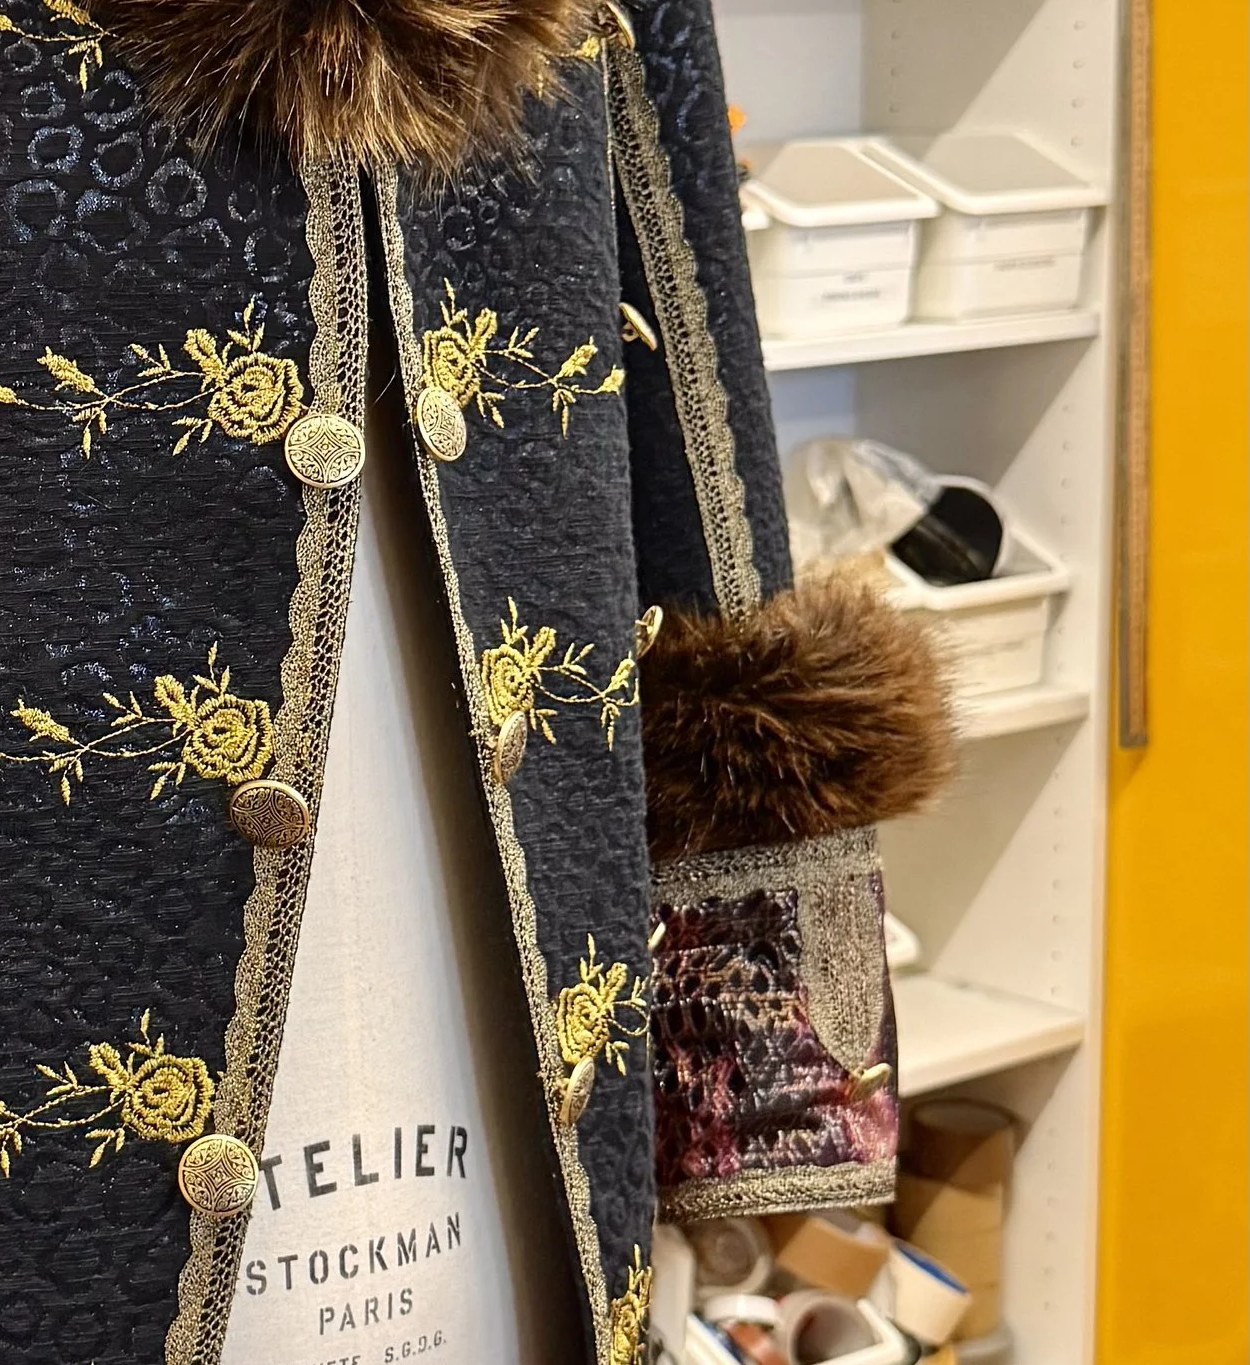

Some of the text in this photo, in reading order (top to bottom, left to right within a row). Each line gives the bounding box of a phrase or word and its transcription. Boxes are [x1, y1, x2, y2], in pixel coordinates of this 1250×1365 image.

[260, 1124, 468, 1211] TELIER
[245, 1212, 462, 1296] STOCKMAN
[319, 1287, 414, 1335] PARIS
[384, 1329, 448, 1364] S.G.D.G.
